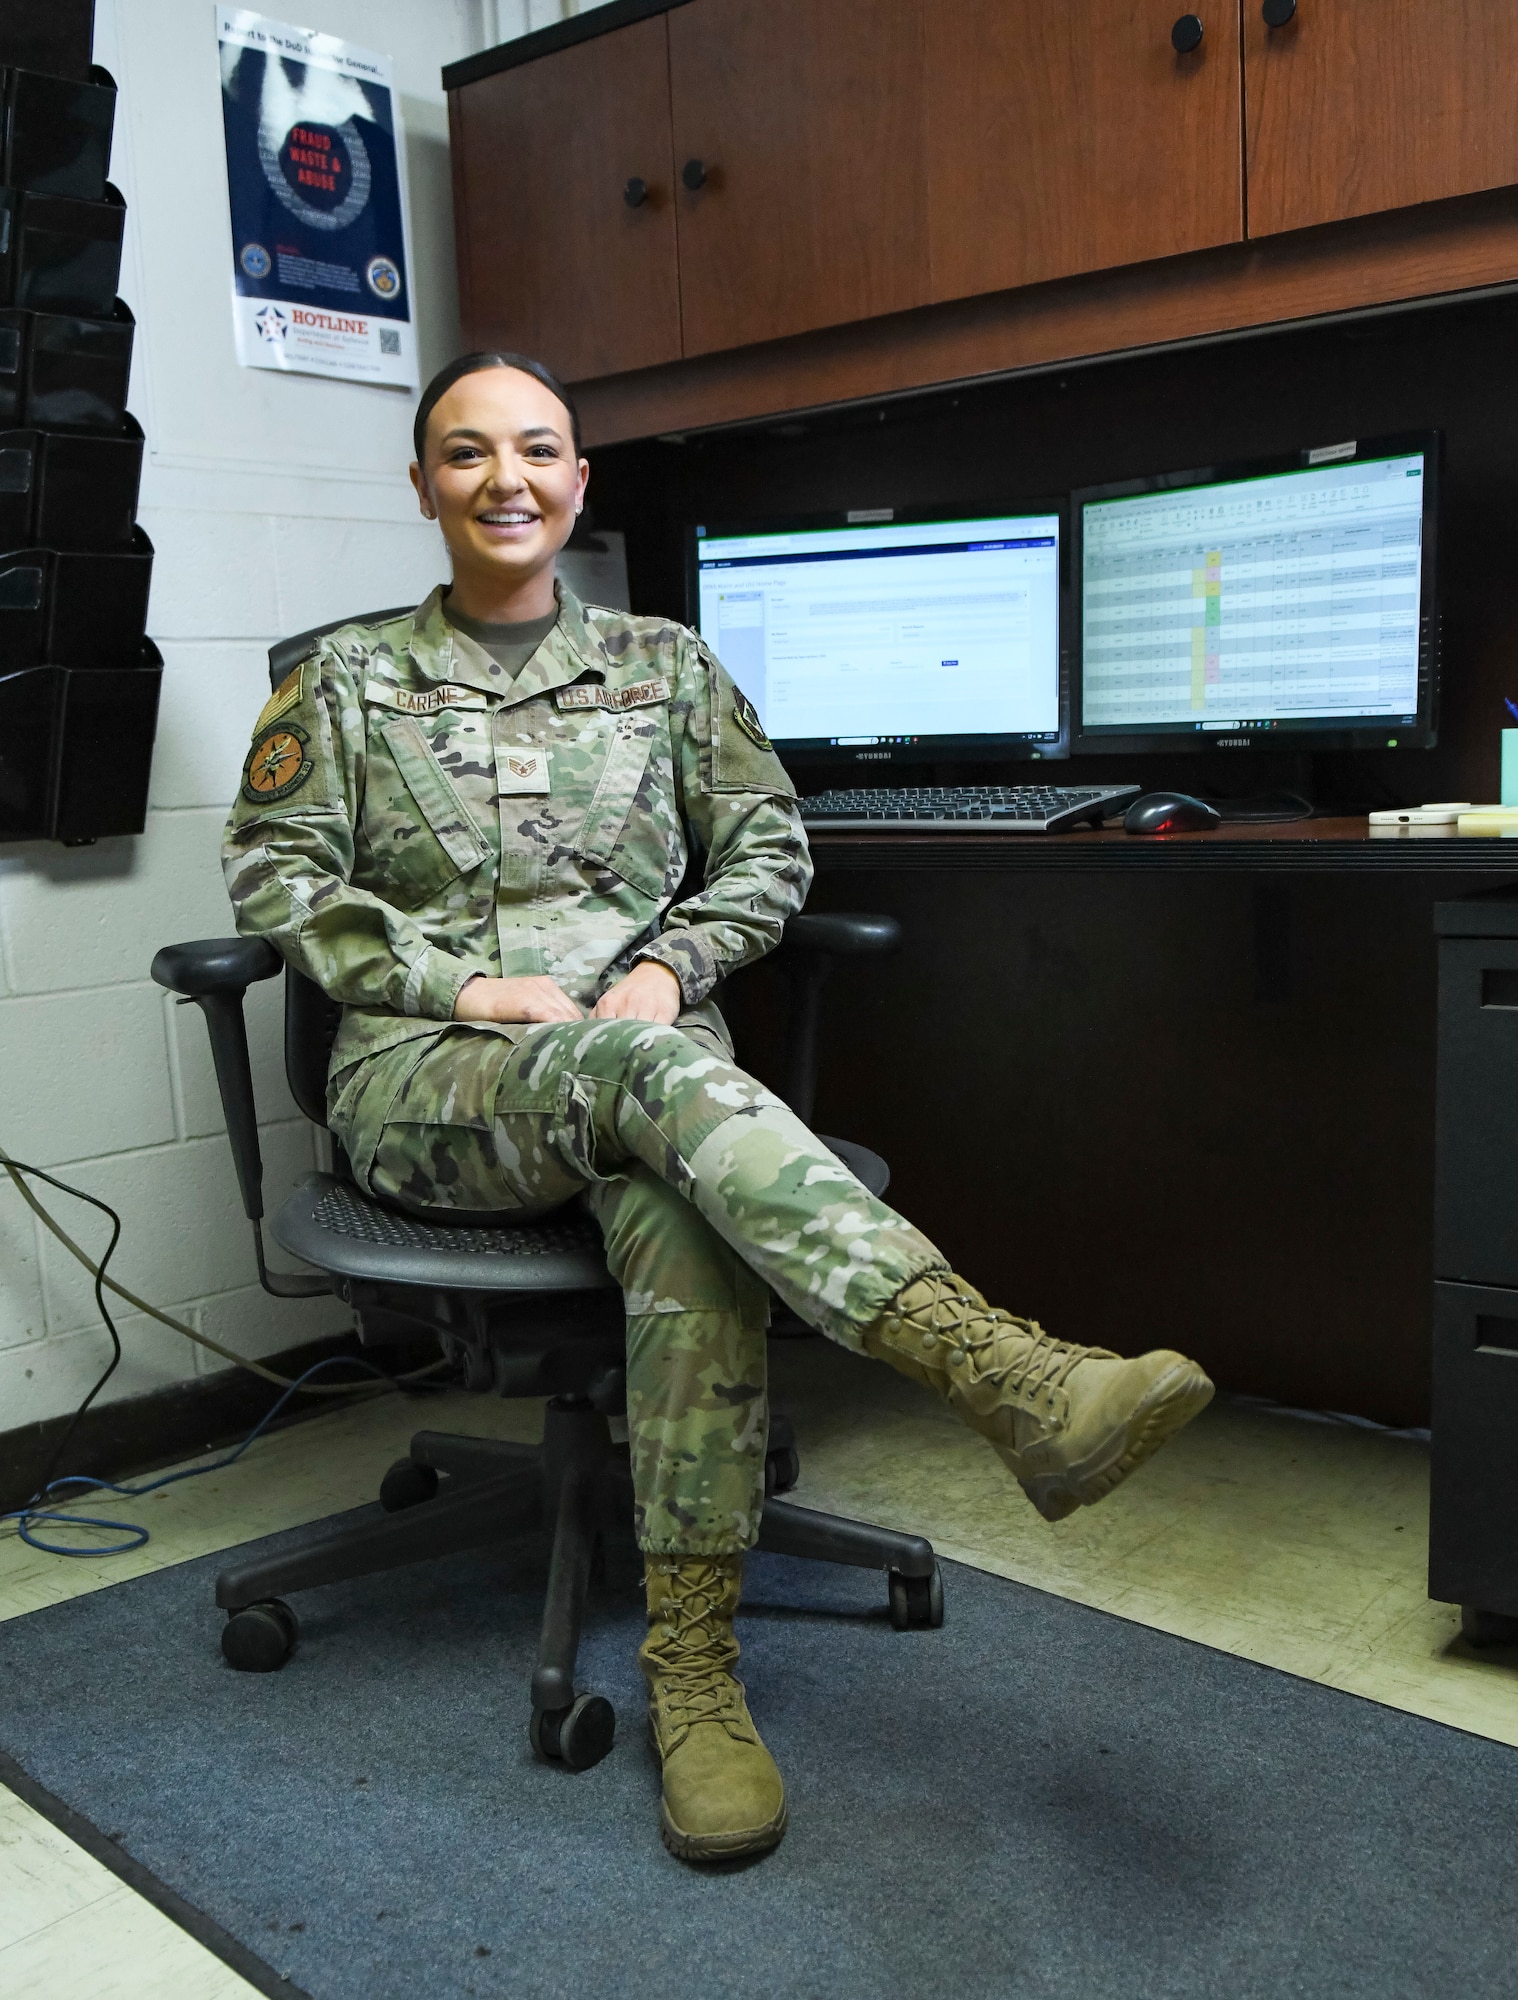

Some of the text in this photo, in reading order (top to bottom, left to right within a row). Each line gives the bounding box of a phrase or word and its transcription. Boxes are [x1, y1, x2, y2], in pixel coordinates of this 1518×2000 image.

[292, 127, 331, 151] FRAUD
[289, 147, 328, 170] WASTE
[298, 168, 335, 192] ABUSE
[292, 309, 368, 335] HOTLINE
[396, 687, 458, 711] CARENE
[611, 682, 665, 710] FORCE
[1219, 738, 1250, 747] HYUNDAI
[858, 752, 892, 760] HYUNDAI
